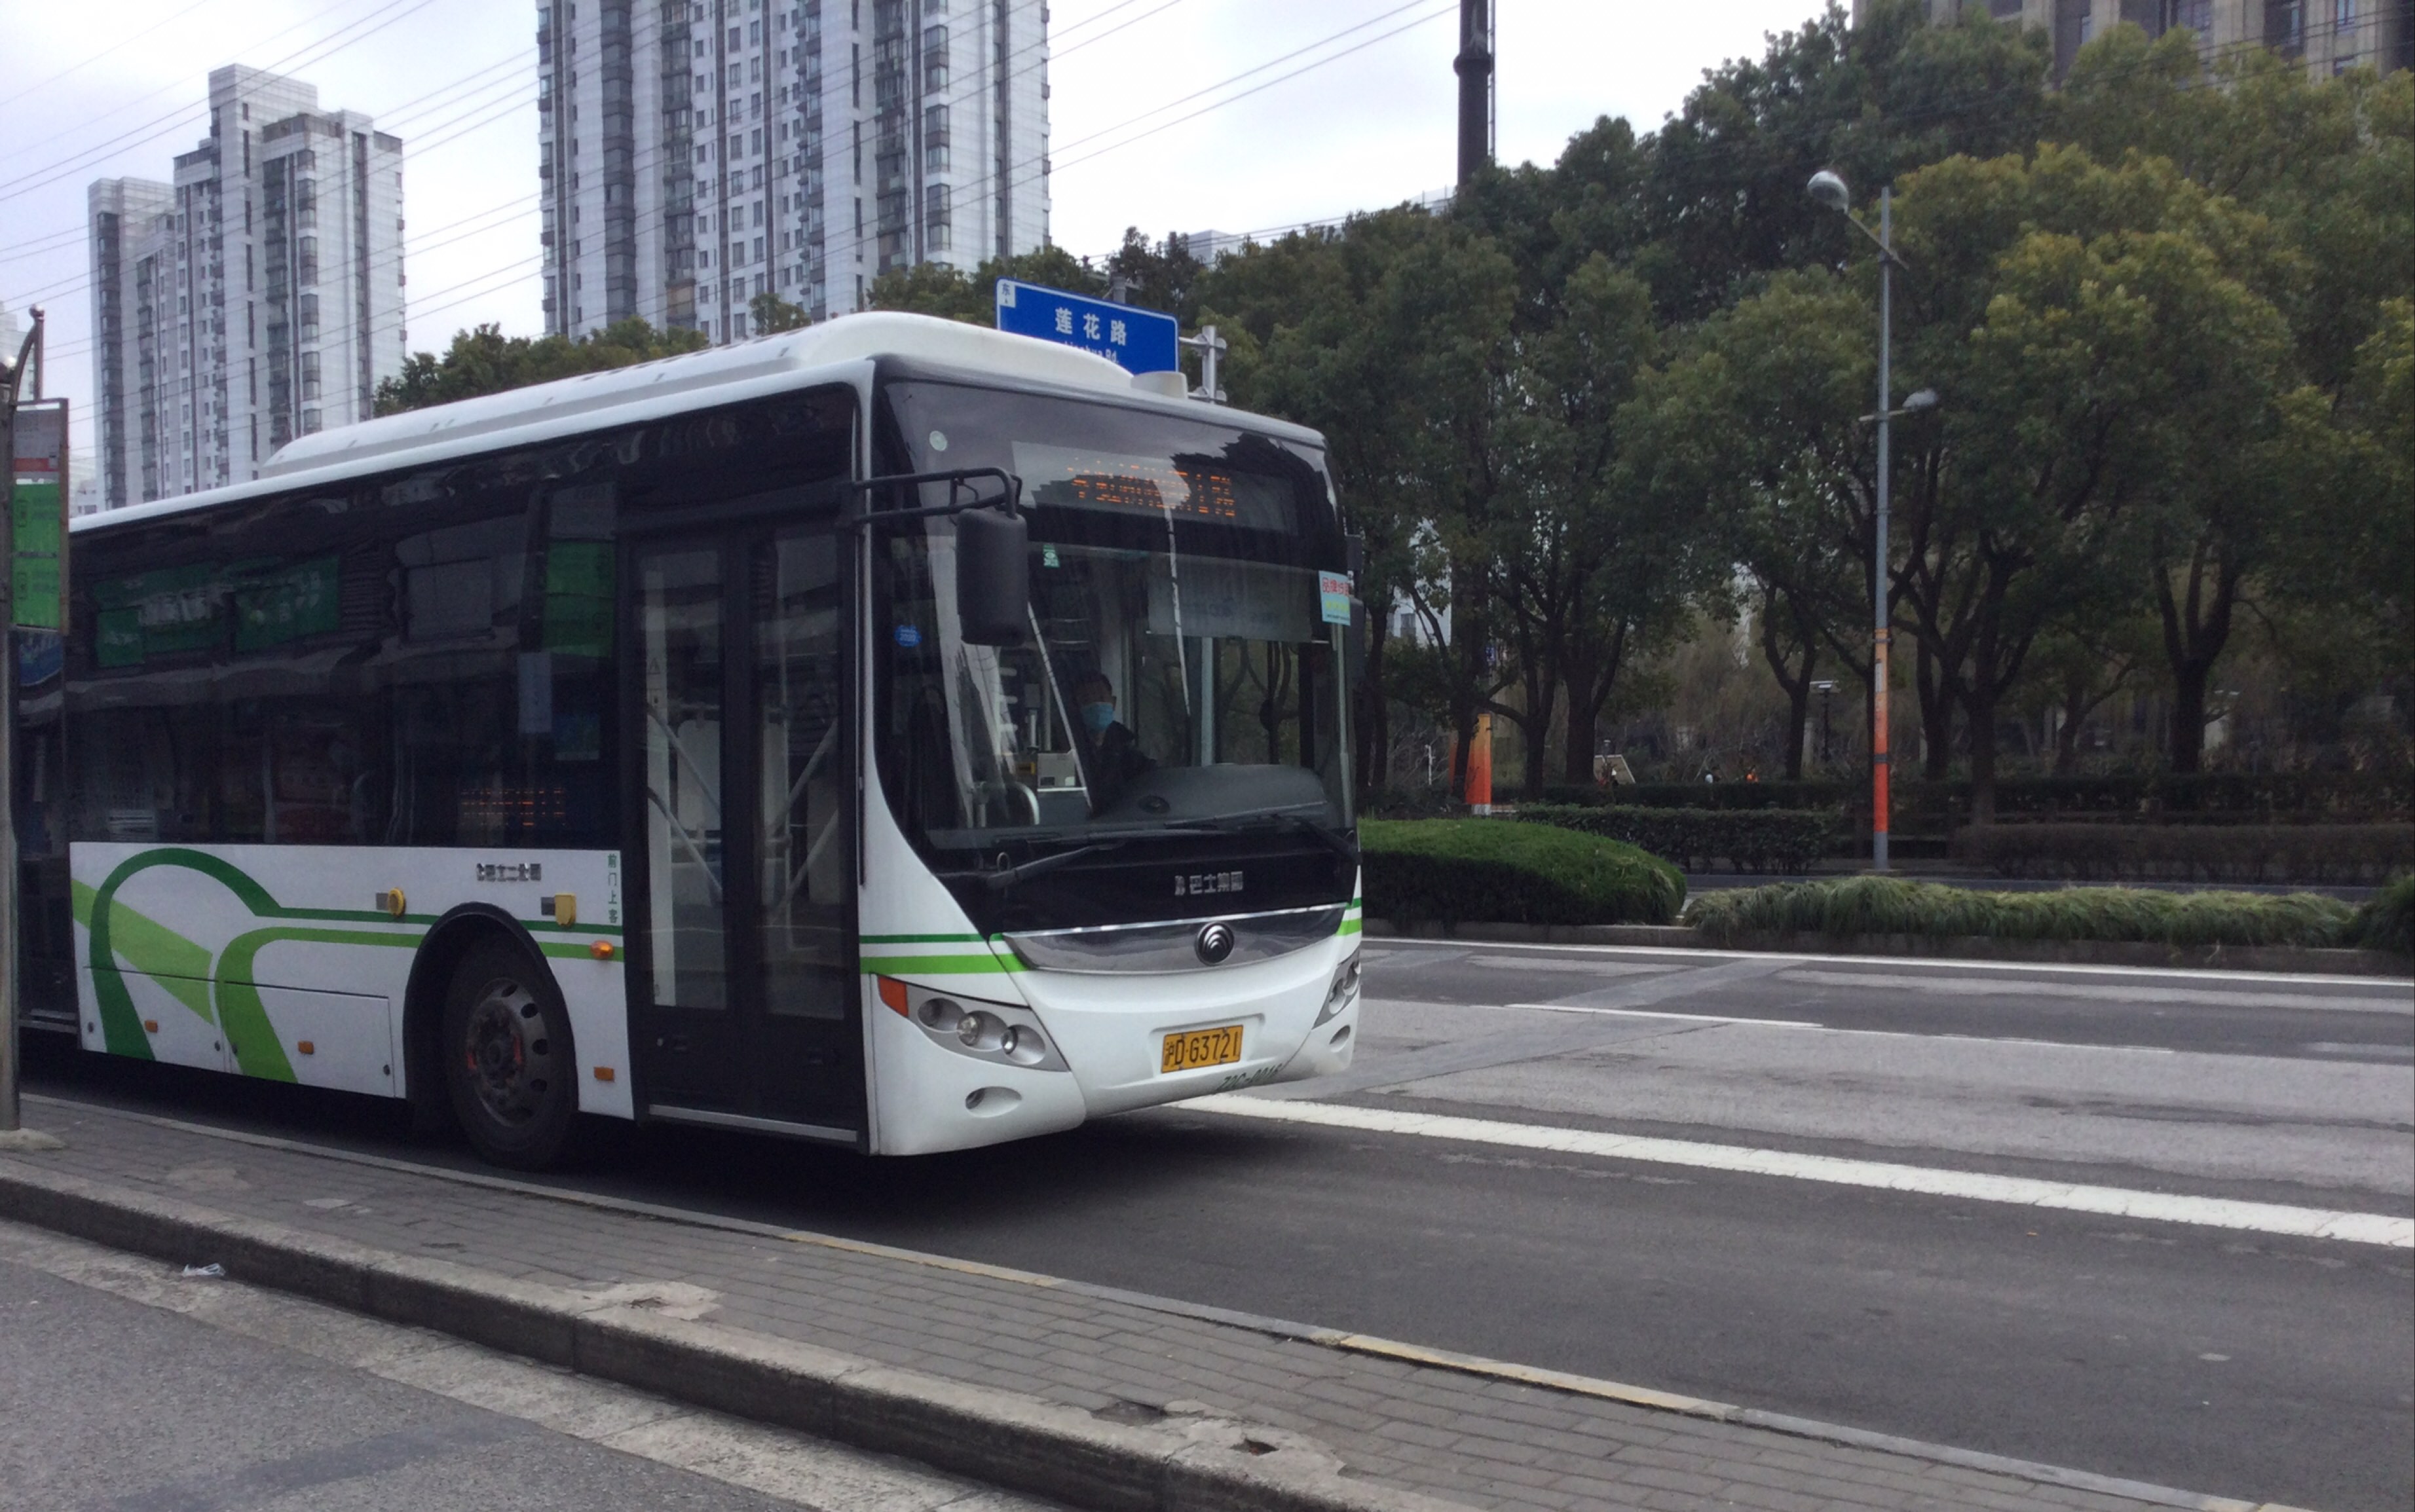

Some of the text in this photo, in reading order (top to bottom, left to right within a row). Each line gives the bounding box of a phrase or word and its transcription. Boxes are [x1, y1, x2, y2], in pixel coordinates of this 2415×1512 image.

[1055, 306, 1127, 346] 莲花路
[608, 853, 618, 924] 前门上客
